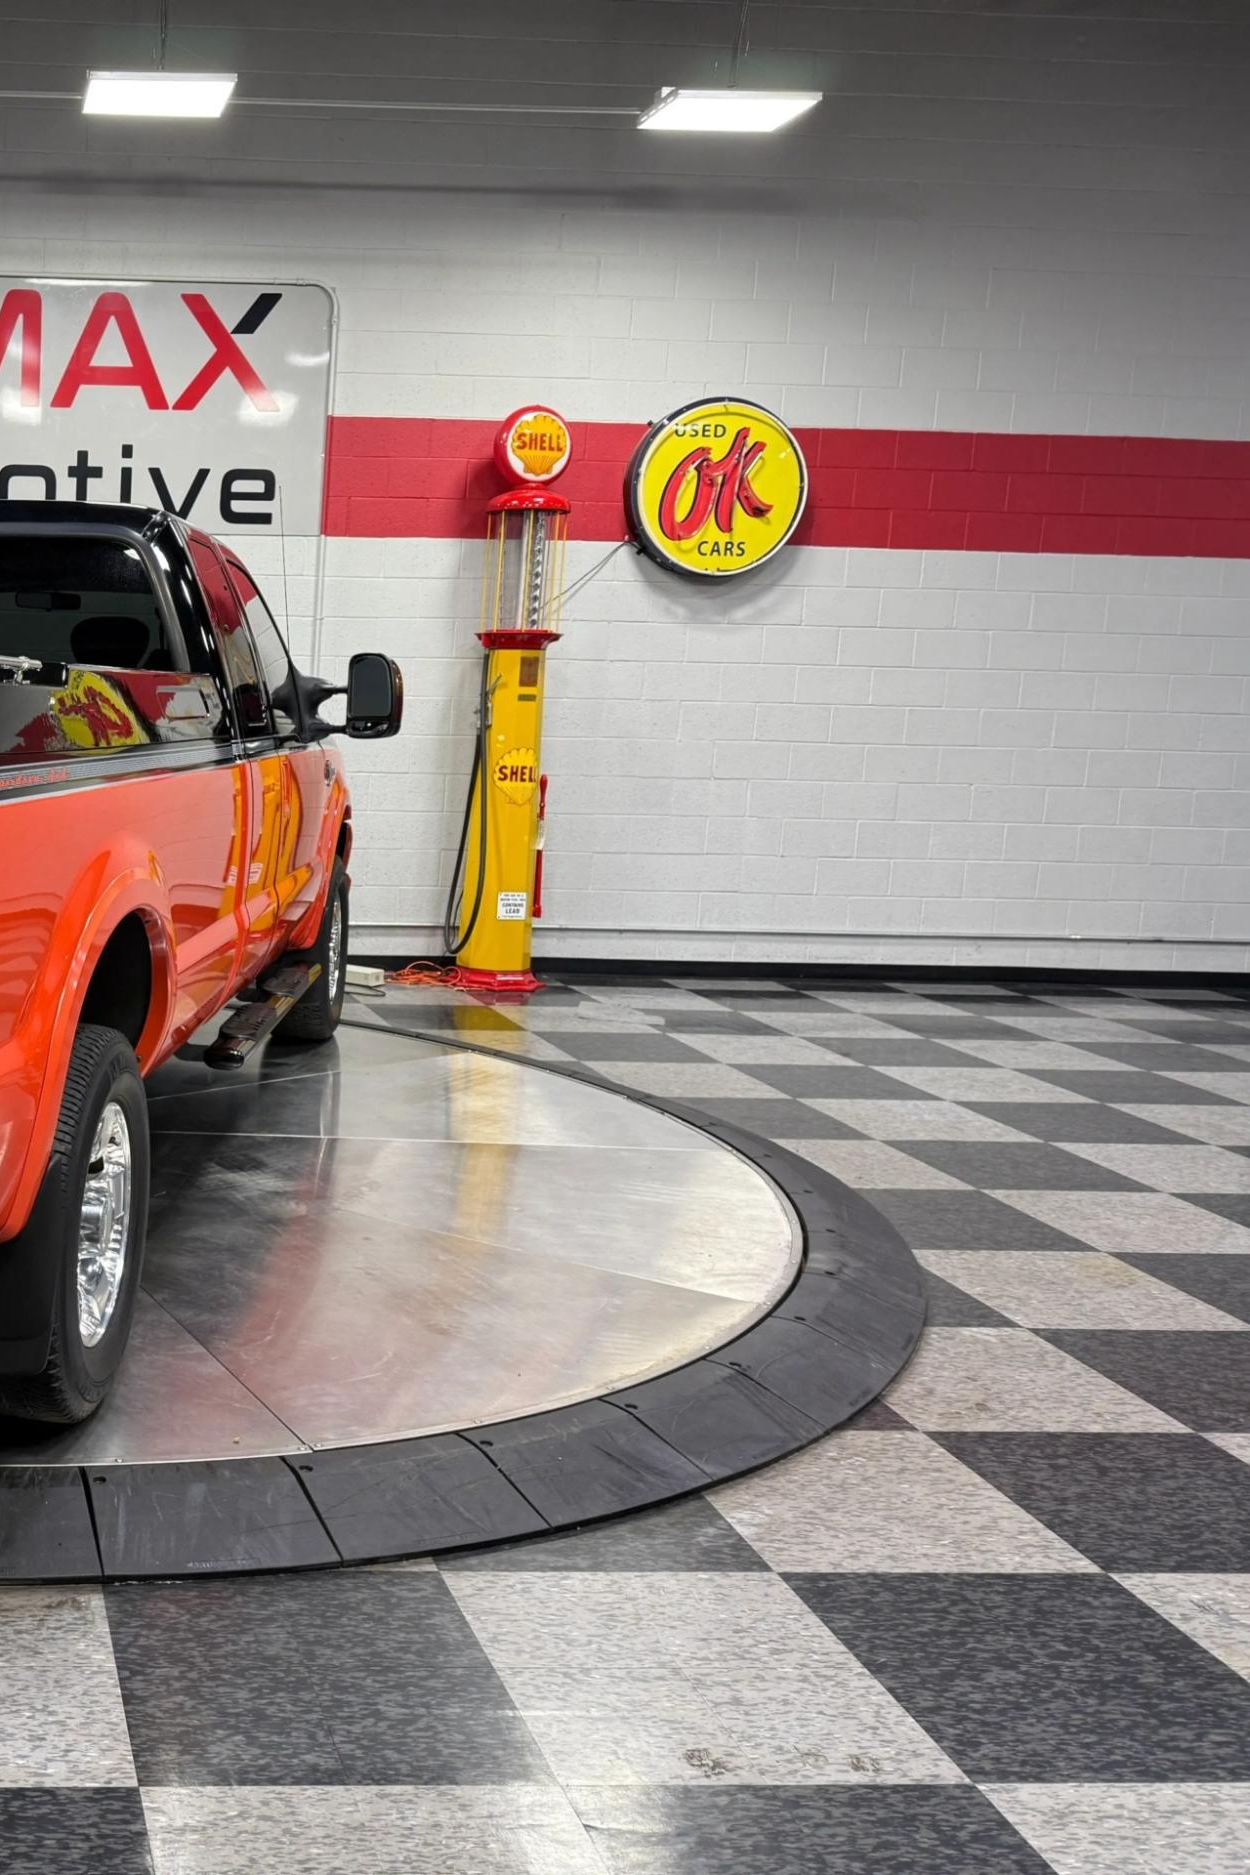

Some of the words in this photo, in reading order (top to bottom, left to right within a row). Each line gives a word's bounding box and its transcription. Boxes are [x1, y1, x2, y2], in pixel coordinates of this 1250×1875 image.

[674, 424, 727, 438] USED
[516, 432, 563, 452] SHELL
[658, 427, 774, 541] OK
[697, 541, 746, 557] CARS
